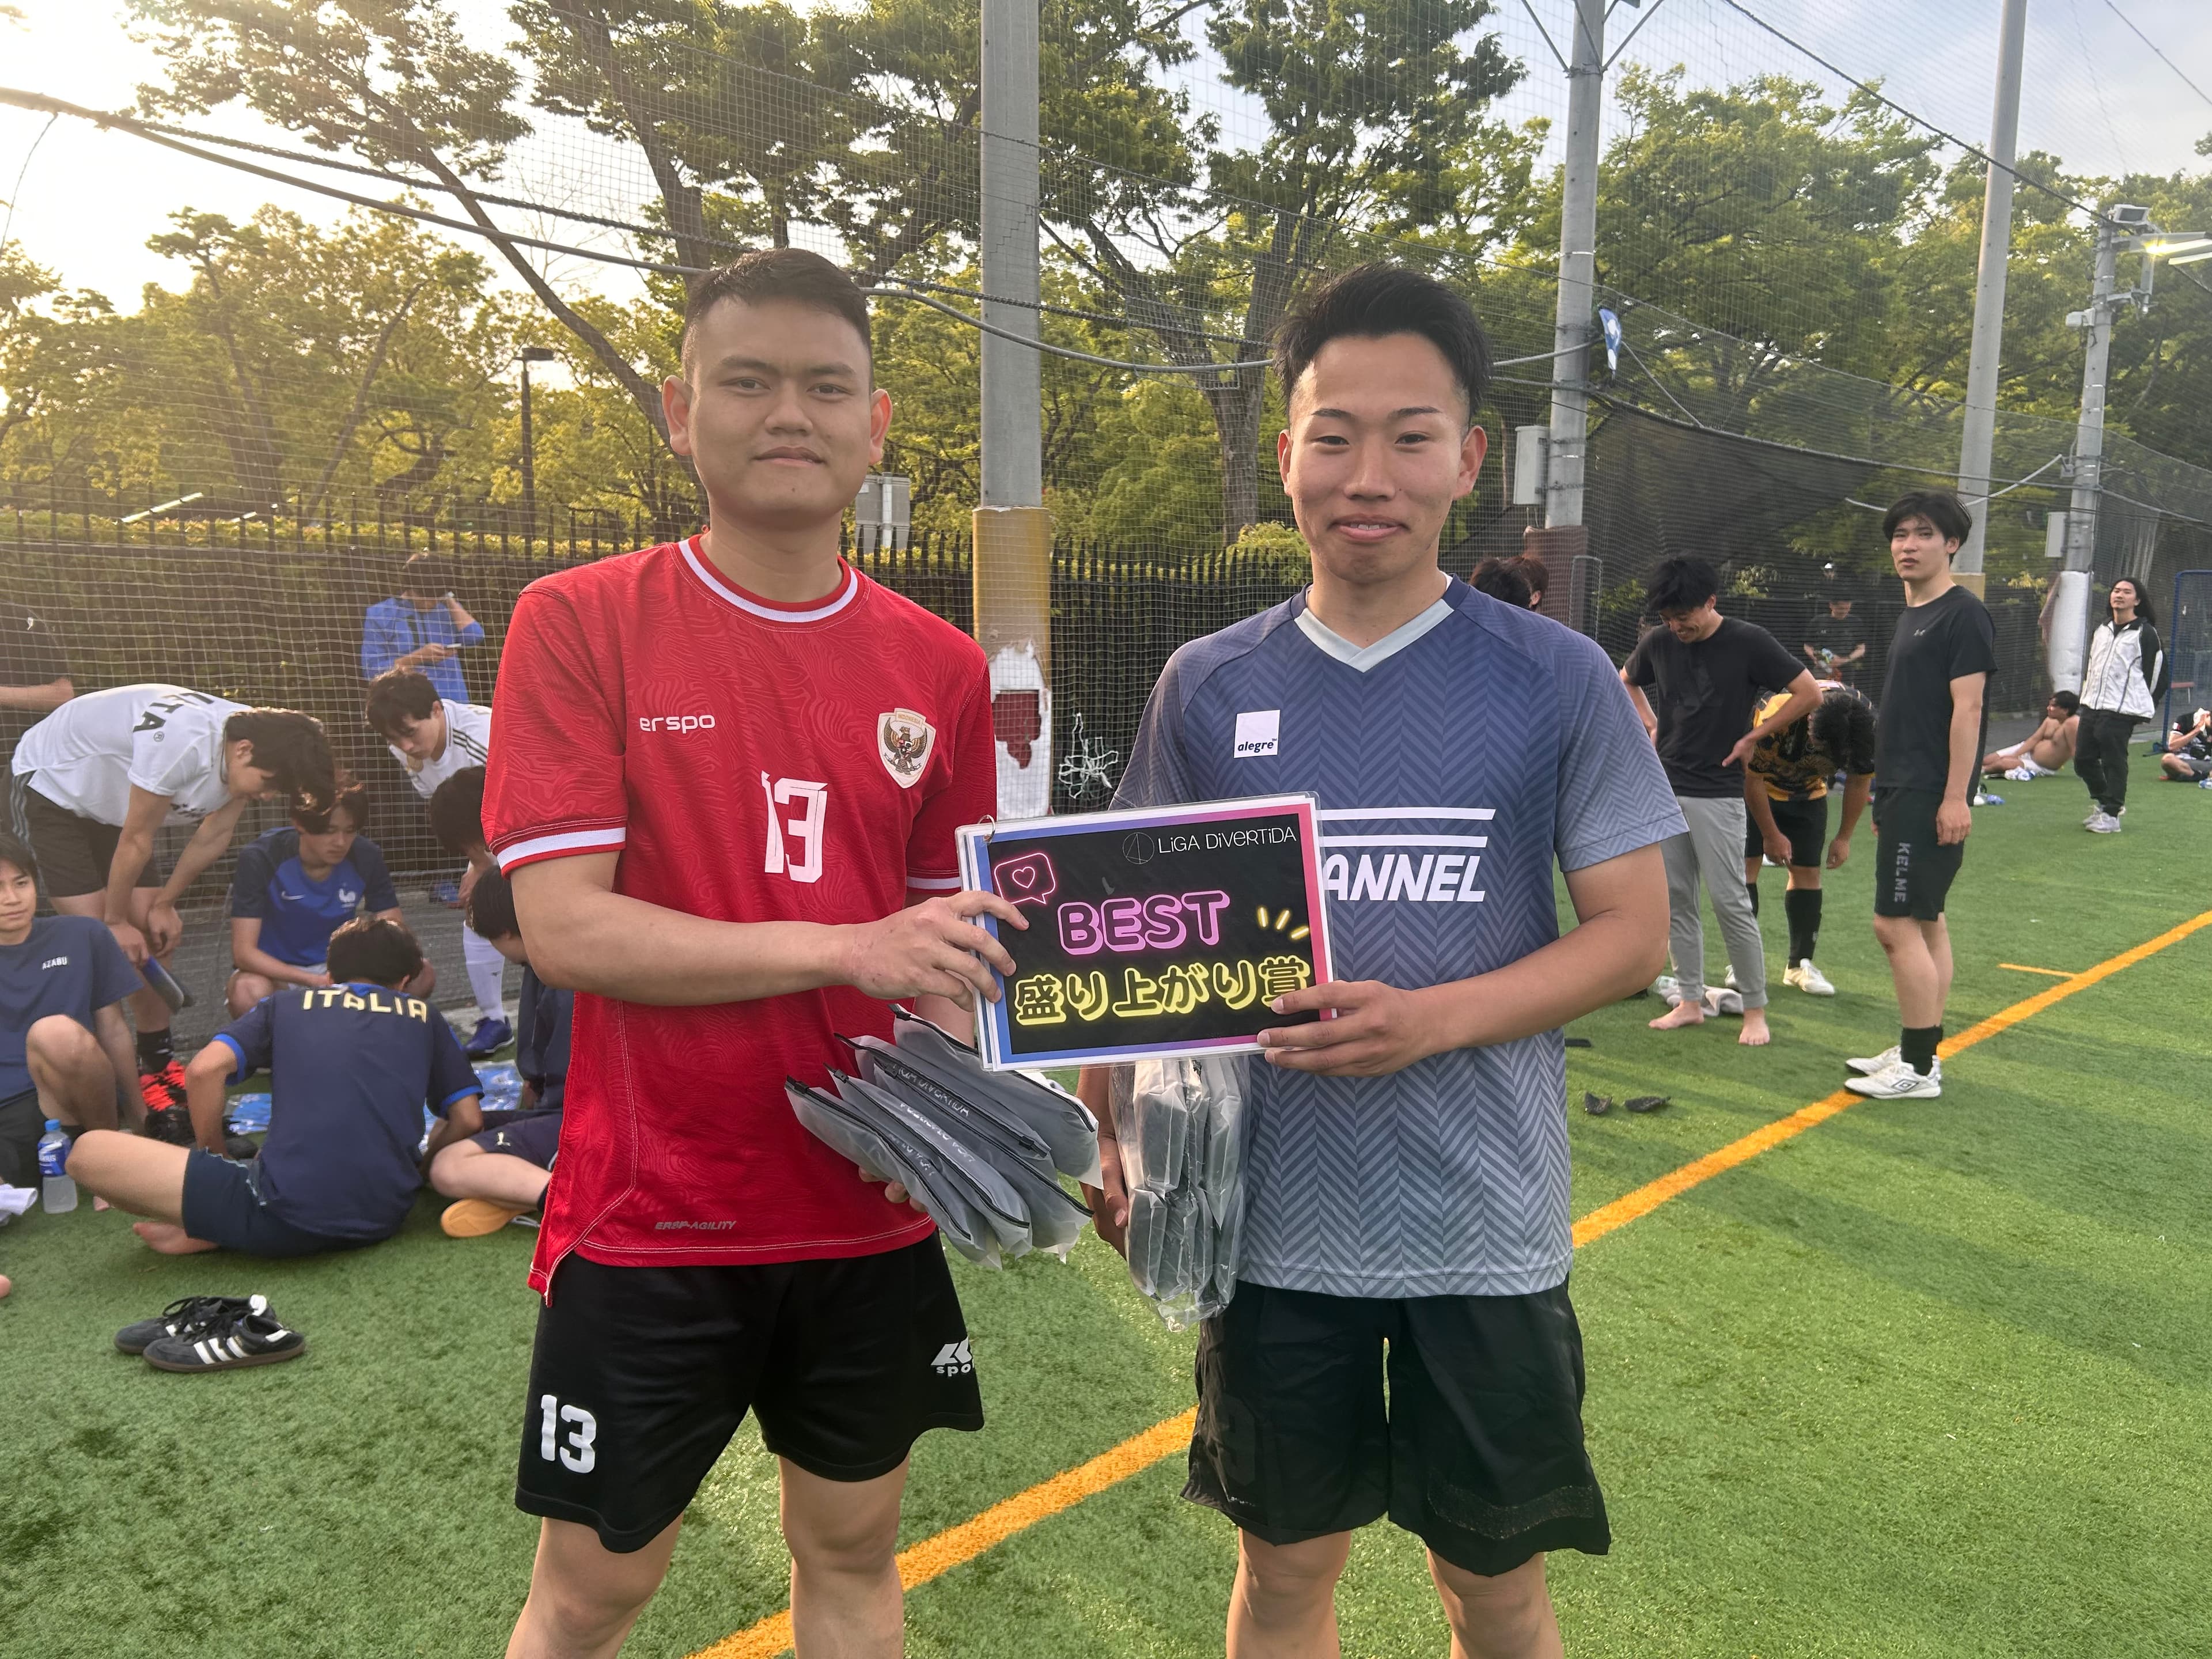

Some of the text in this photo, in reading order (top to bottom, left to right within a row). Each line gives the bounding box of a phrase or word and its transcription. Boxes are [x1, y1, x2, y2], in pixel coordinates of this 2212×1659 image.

[639, 715, 715, 734] erspo
[1237, 741, 1274, 753] alegre
[760, 770, 828, 883] 13
[1894, 842, 1911, 903] KELME
[1056, 889, 1230, 955] BEST
[42, 956, 67, 971] AZABU
[302, 990, 427, 1024] ITALIA
[1014, 955, 1310, 1026] 盛り上がり賞
[936, 1359, 975, 1377] spo
[540, 1394, 597, 1474] 13
